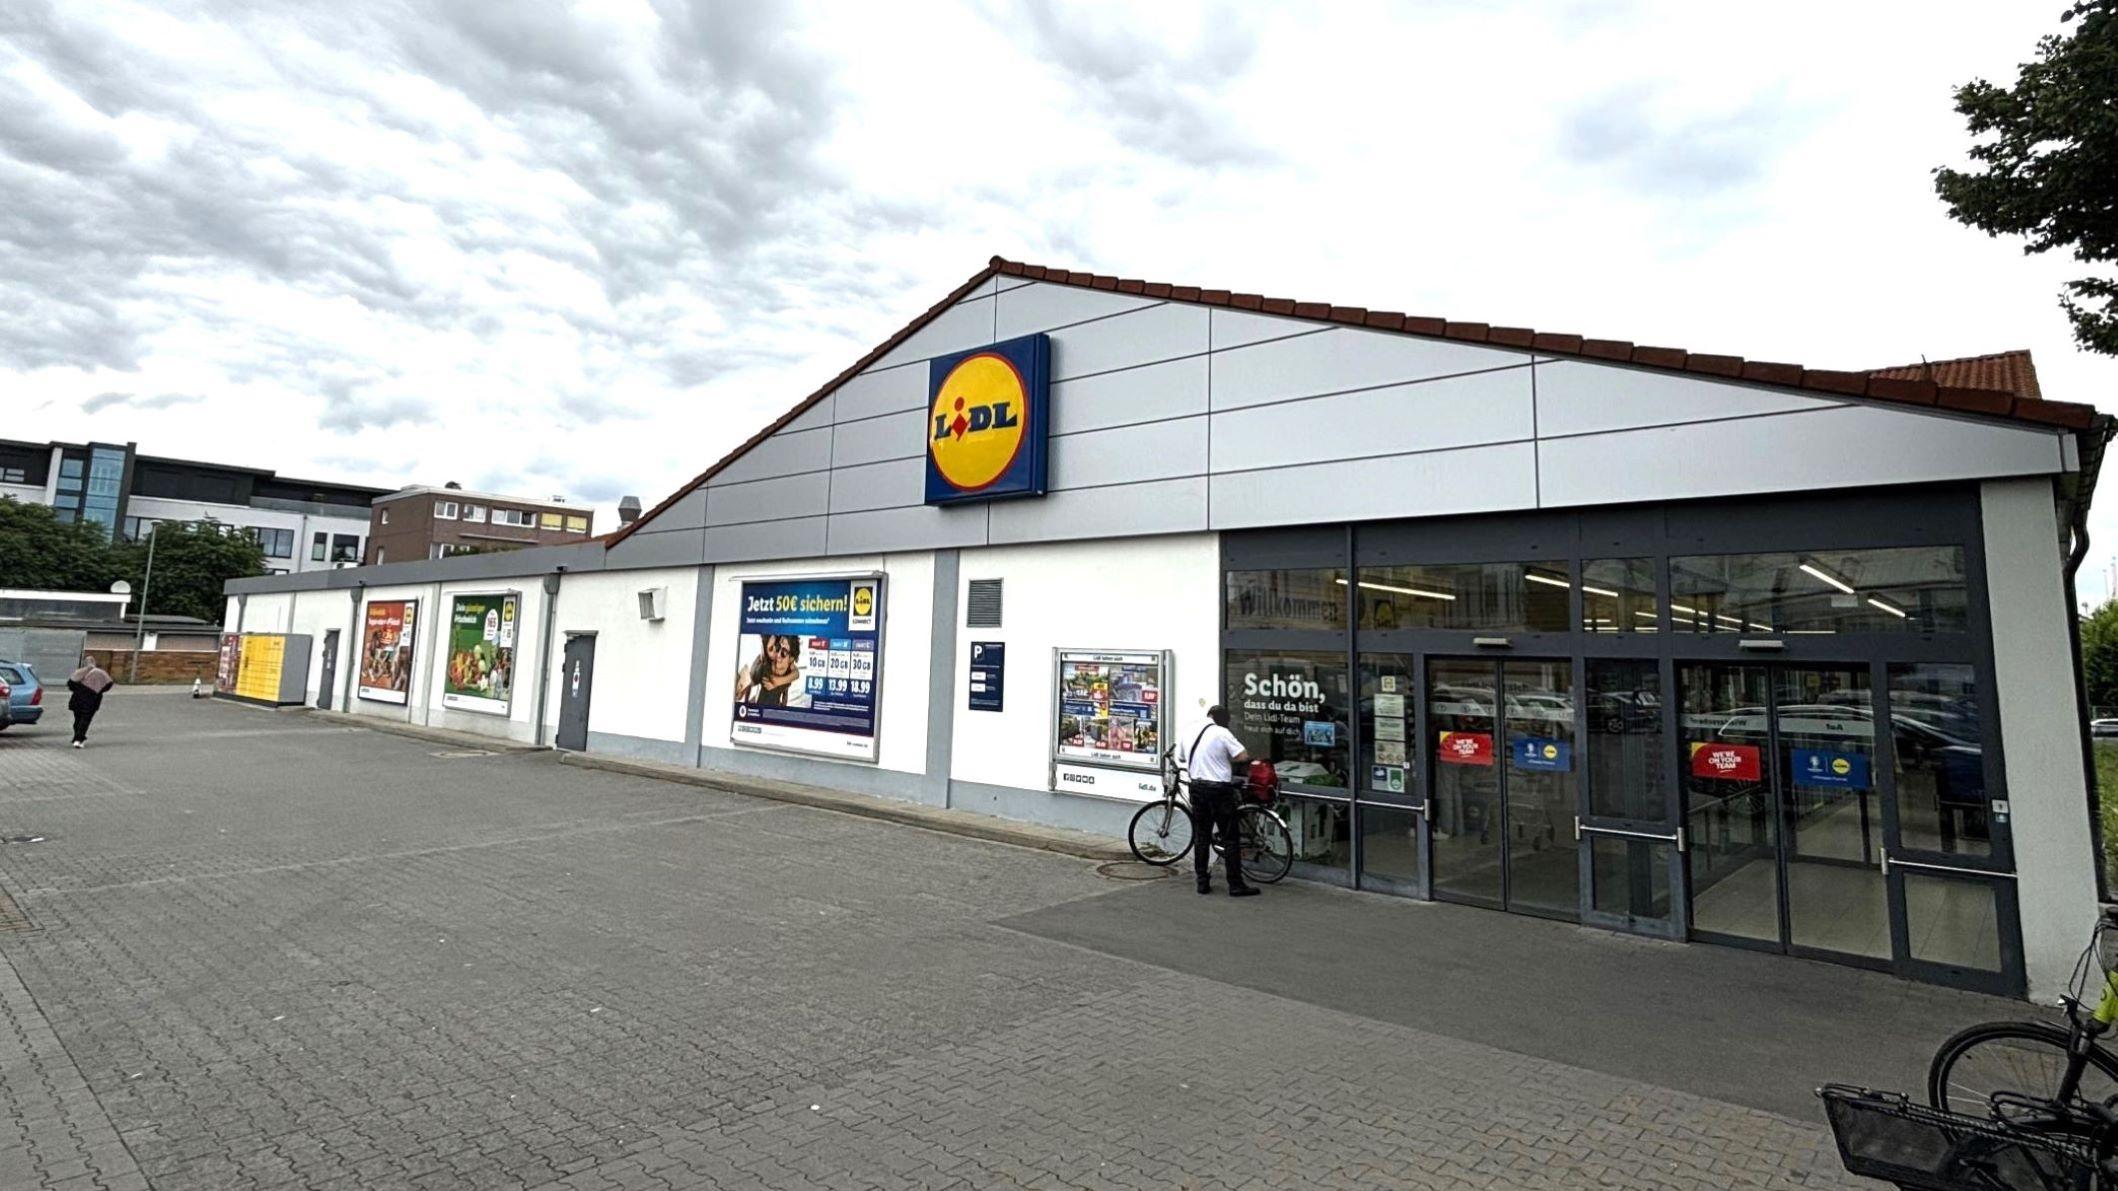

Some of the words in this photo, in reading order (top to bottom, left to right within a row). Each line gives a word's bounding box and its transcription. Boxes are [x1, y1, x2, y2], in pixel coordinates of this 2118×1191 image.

[934, 397, 1018, 442] LIDL
[747, 596, 774, 612] Jetzt
[776, 595, 798, 611] 50€
[800, 594, 848, 612] sichern!
[1238, 587, 1338, 622] Willkommen
[974, 645, 983, 659] P
[809, 656, 816, 667] 10
[830, 658, 839, 669] 20
[840, 662, 849, 670] GB
[852, 659, 861, 670] 30
[862, 662, 871, 671] GB
[851, 681, 871, 694] 18.99
[1244, 672, 1326, 704] Schön,
[1244, 700, 1266, 710] dass
[1268, 701, 1281, 710] du
[1283, 701, 1297, 712] da
[1299, 702, 1319, 713] bist
[1244, 711, 1261, 720] Dein
[1286, 727, 1300, 736] dich
[1719, 756, 1742, 764] YOUR
